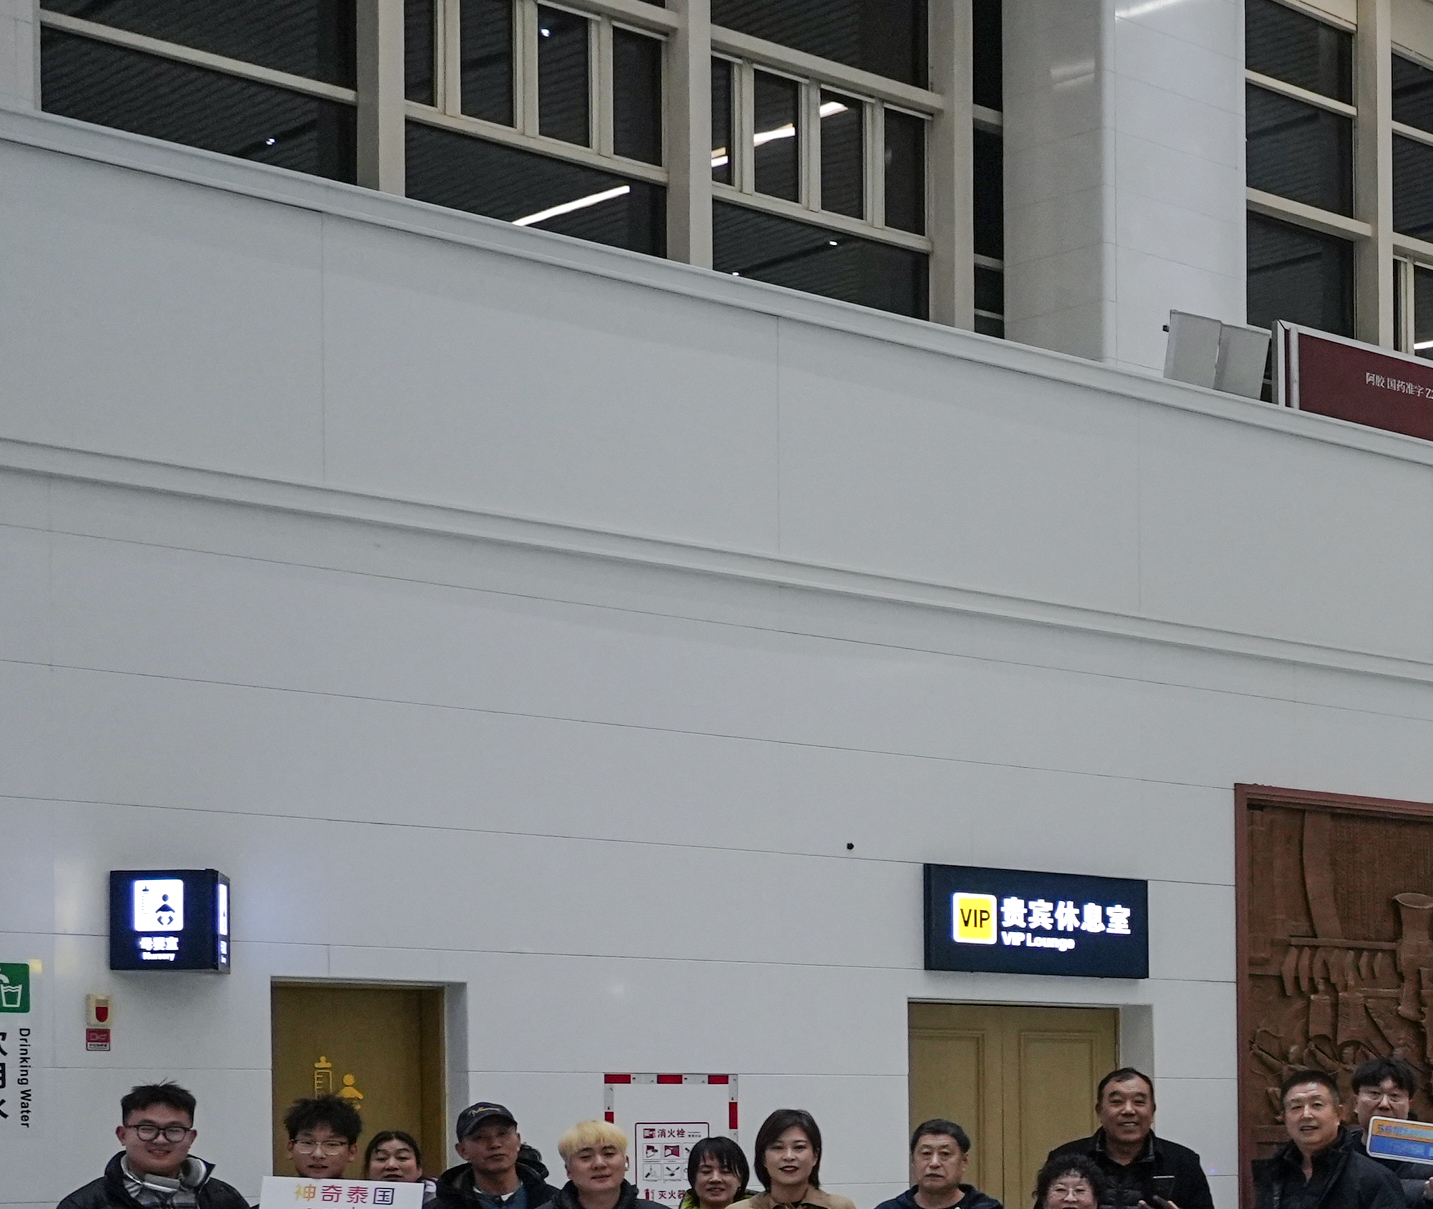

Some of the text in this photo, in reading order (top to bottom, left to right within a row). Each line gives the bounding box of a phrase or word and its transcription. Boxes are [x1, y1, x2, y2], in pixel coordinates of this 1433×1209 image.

[1365, 372, 1385, 388] 阿胶
[1386, 377, 1424, 397] 国药准字
[960, 908, 991, 929] VIP
[1000, 896, 1132, 935] 贵宾休息室
[1000, 931, 1076, 952] VIP Lounge
[17, 1028, 32, 1129] Drinking Water
[657, 1128, 686, 1138] 消火栓
[295, 1184, 396, 1206] 神奇泰国
